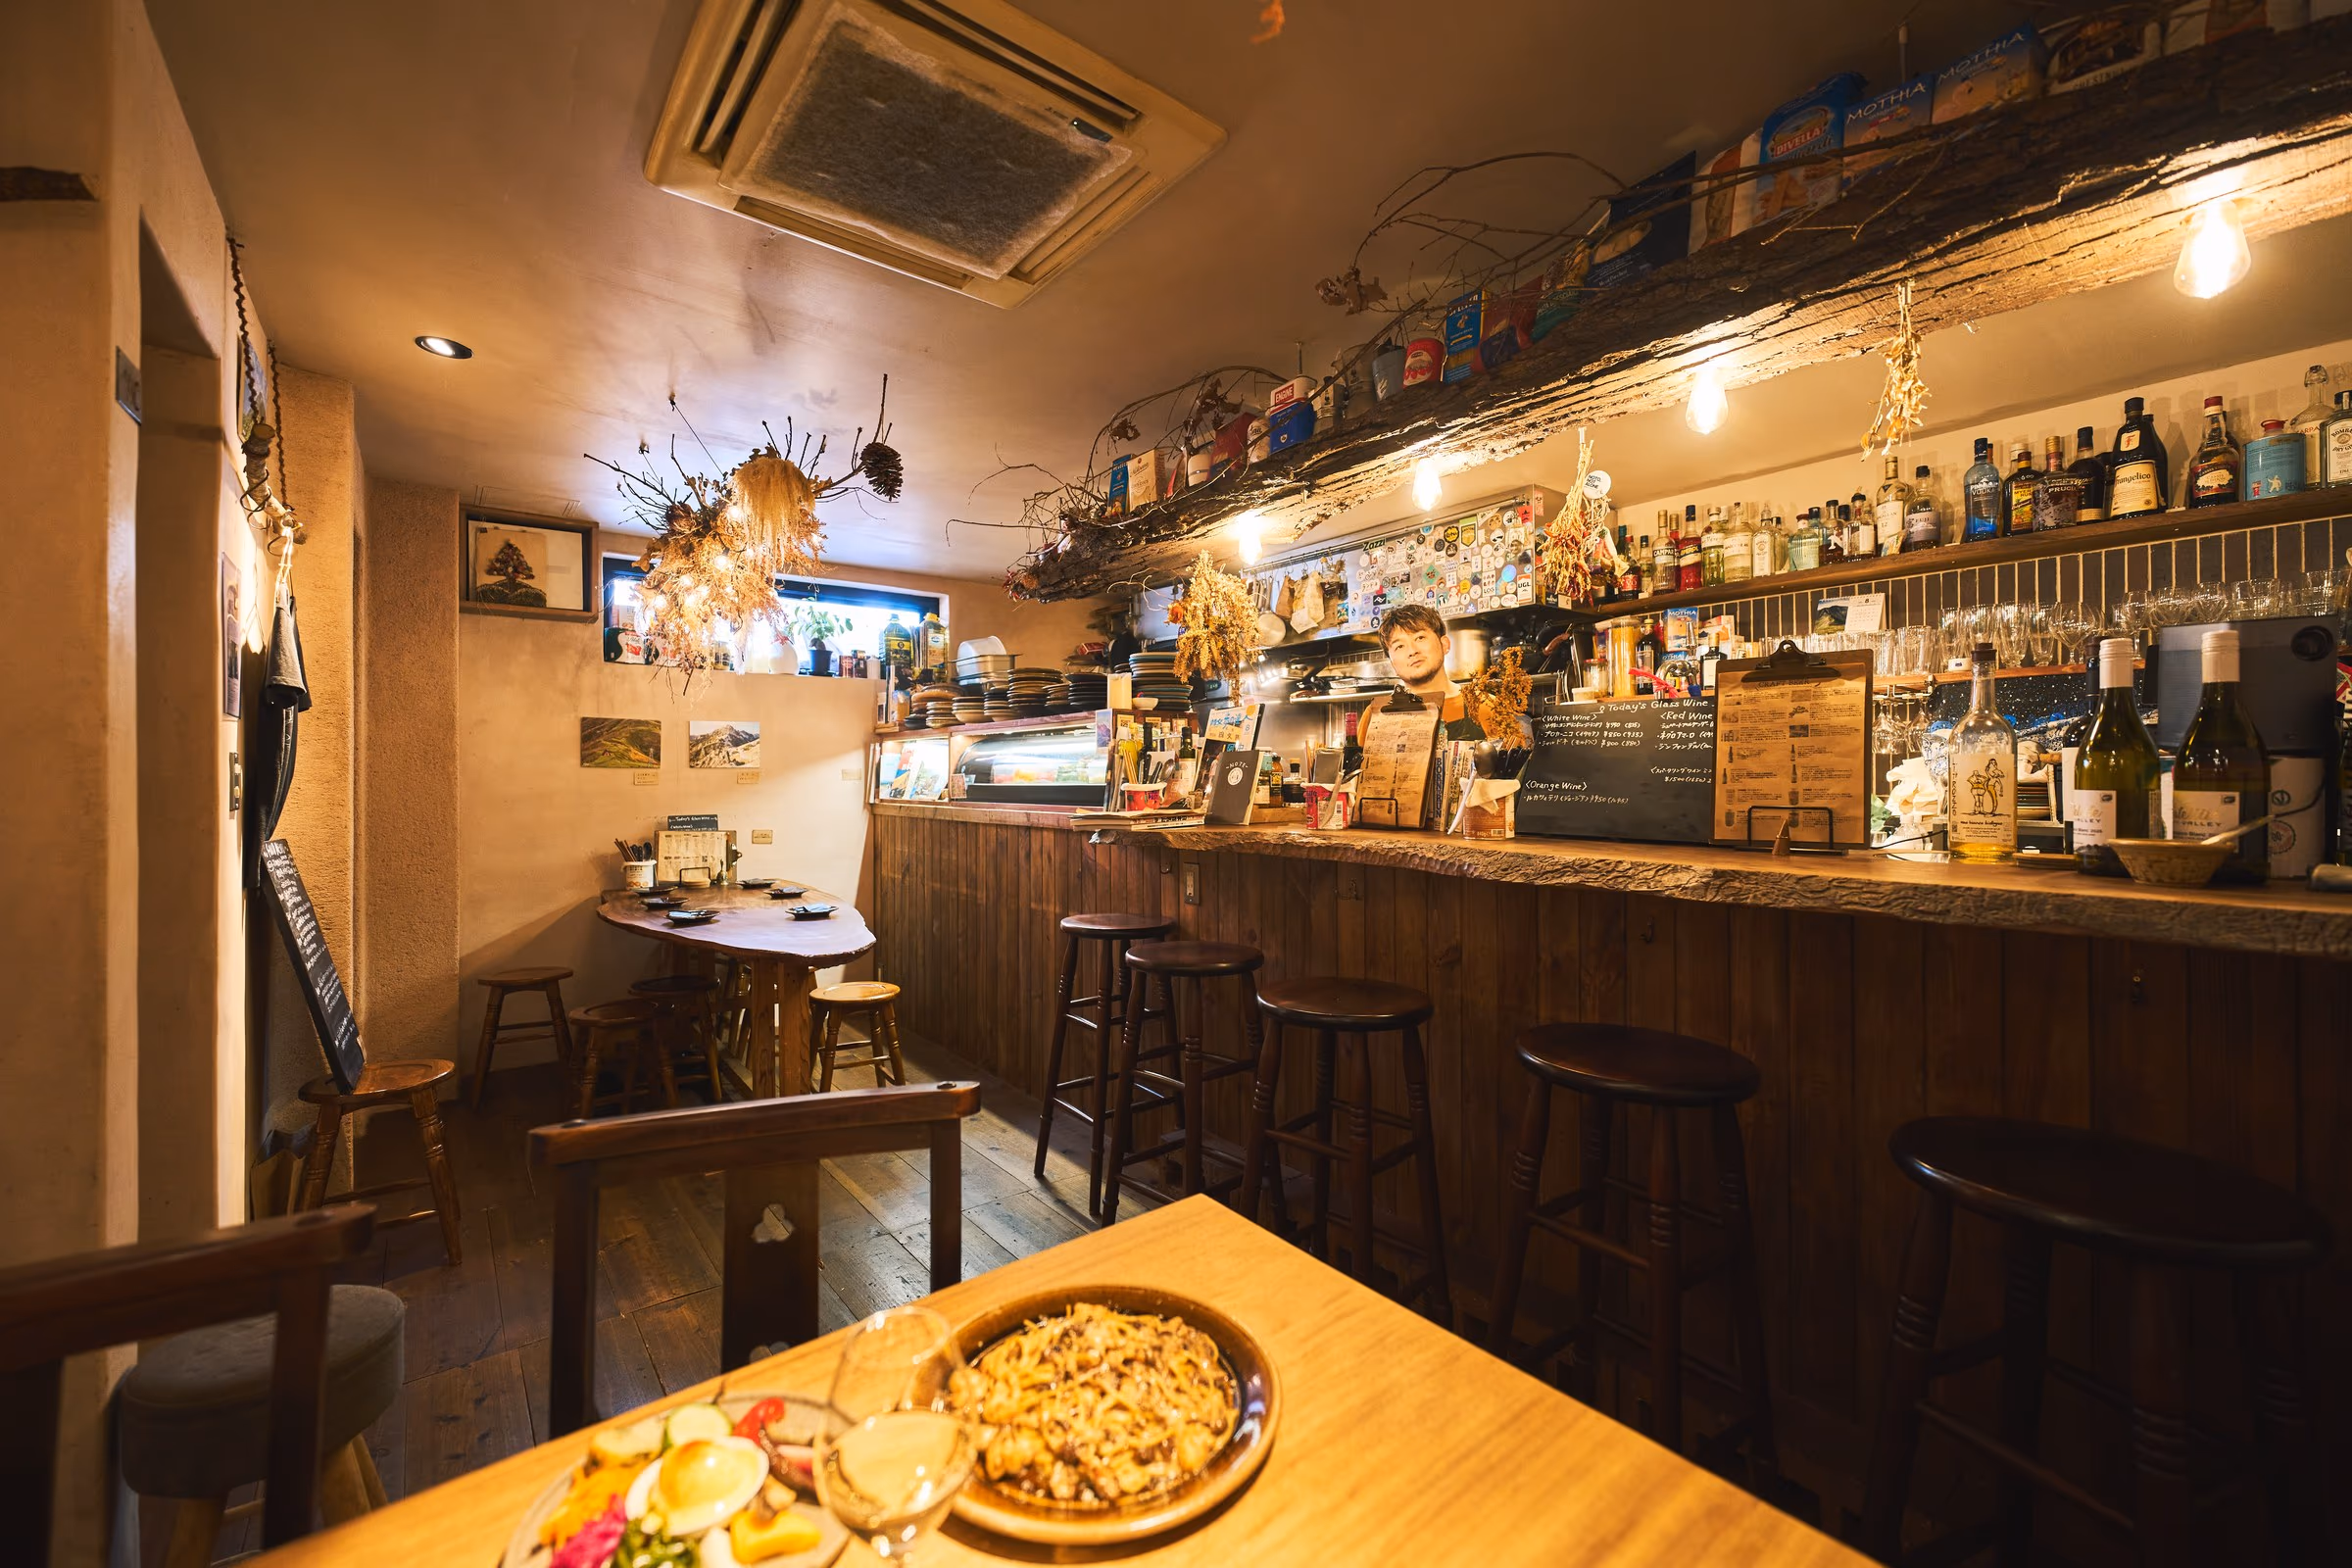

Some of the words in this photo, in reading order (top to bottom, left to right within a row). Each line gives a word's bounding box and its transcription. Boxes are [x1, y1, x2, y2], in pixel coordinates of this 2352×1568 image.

[1937, 32, 2025, 84] MOTHIA
[1845, 81, 1927, 125] MOTHIA
[1776, 128, 1821, 155] DIVELLA
[1275, 386, 1294, 403] ENGINE
[2331, 428, 2352, 438] BOMB
[1362, 539, 1386, 552] Zazzi
[1653, 548, 1675, 557] CAMPAR
[1607, 702, 1647, 713] Today's
[1650, 700, 1680, 710] Glass
[1682, 699, 1709, 708] Wine
